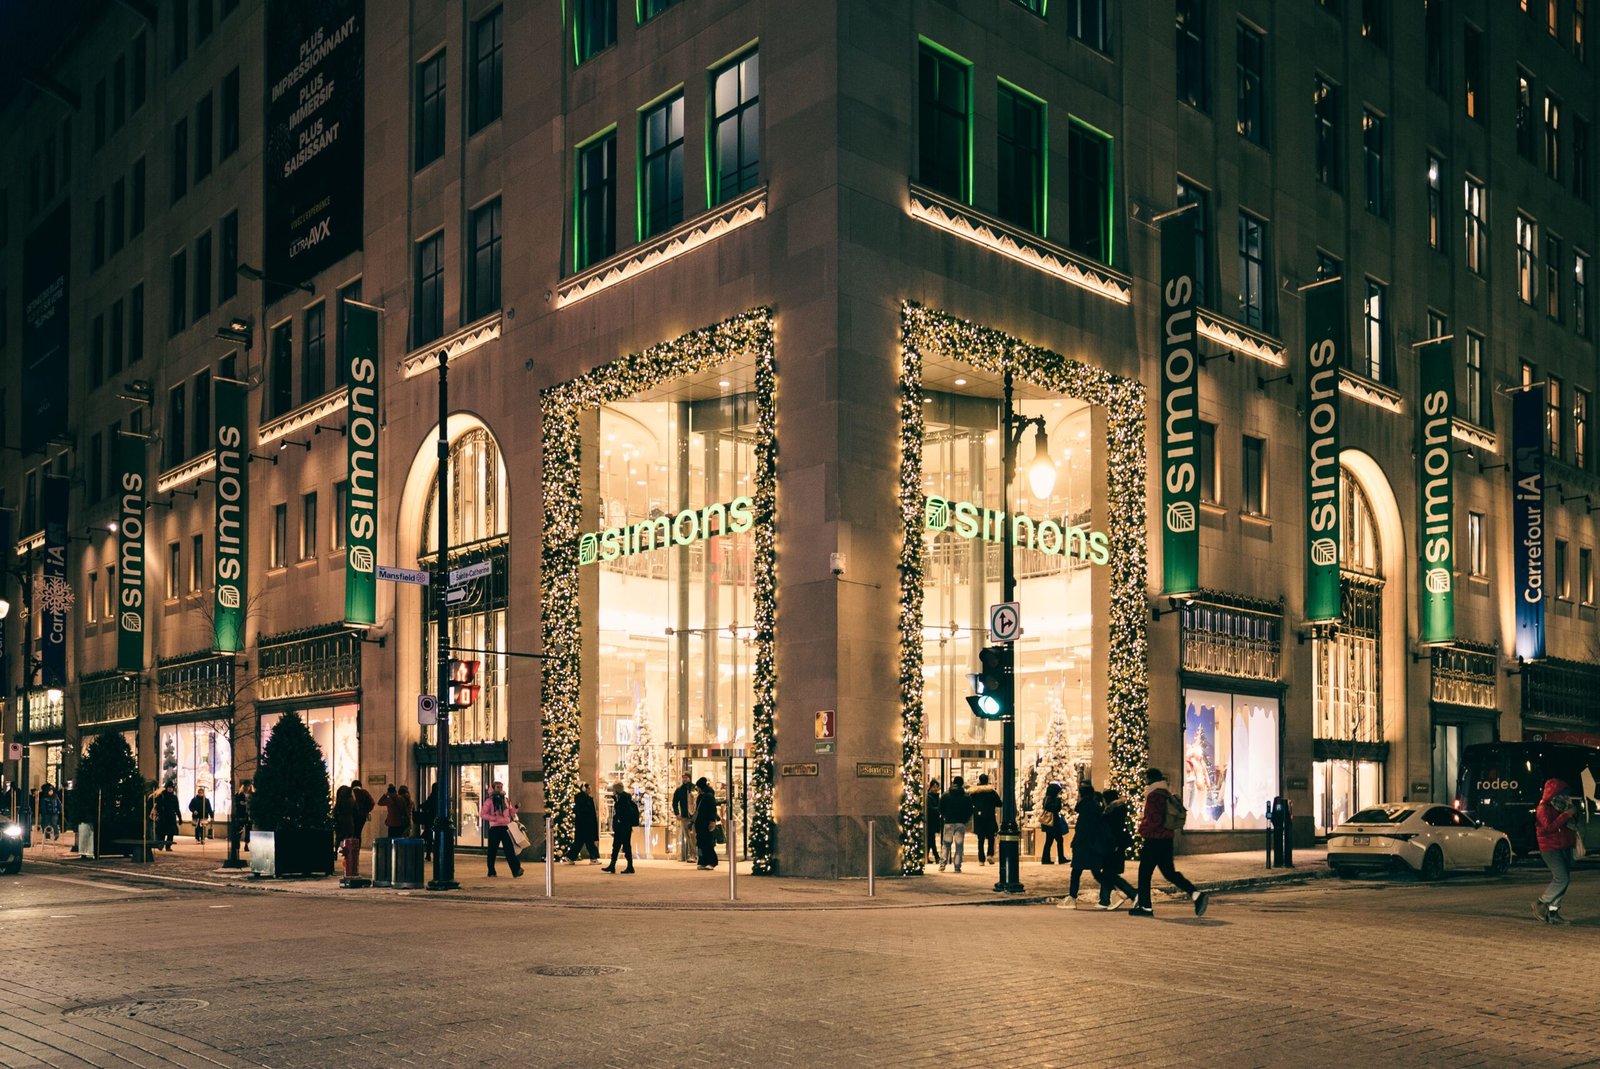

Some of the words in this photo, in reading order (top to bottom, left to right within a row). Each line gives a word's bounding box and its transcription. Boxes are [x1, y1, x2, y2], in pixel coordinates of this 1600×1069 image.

[299, 26, 324, 61] PLUS
[289, 79, 335, 131] IMMERSIF
[299, 71, 324, 105] PLUS
[283, 120, 340, 178] SAISISSANT
[299, 116, 324, 150] PLUS
[1164, 274, 1196, 494] simons
[349, 355, 375, 540] simons
[1309, 338, 1337, 531] simons
[218, 425, 241, 580] simons
[1423, 389, 1450, 563] simons
[1516, 473, 1541, 500] iA
[121, 472, 143, 607] simons
[601, 495, 754, 561] simons
[955, 501, 1110, 566] simons
[1524, 506, 1542, 604] Carrefour
[379, 570, 416, 582] Mansfield
[1477, 778, 1519, 790] rodeo
